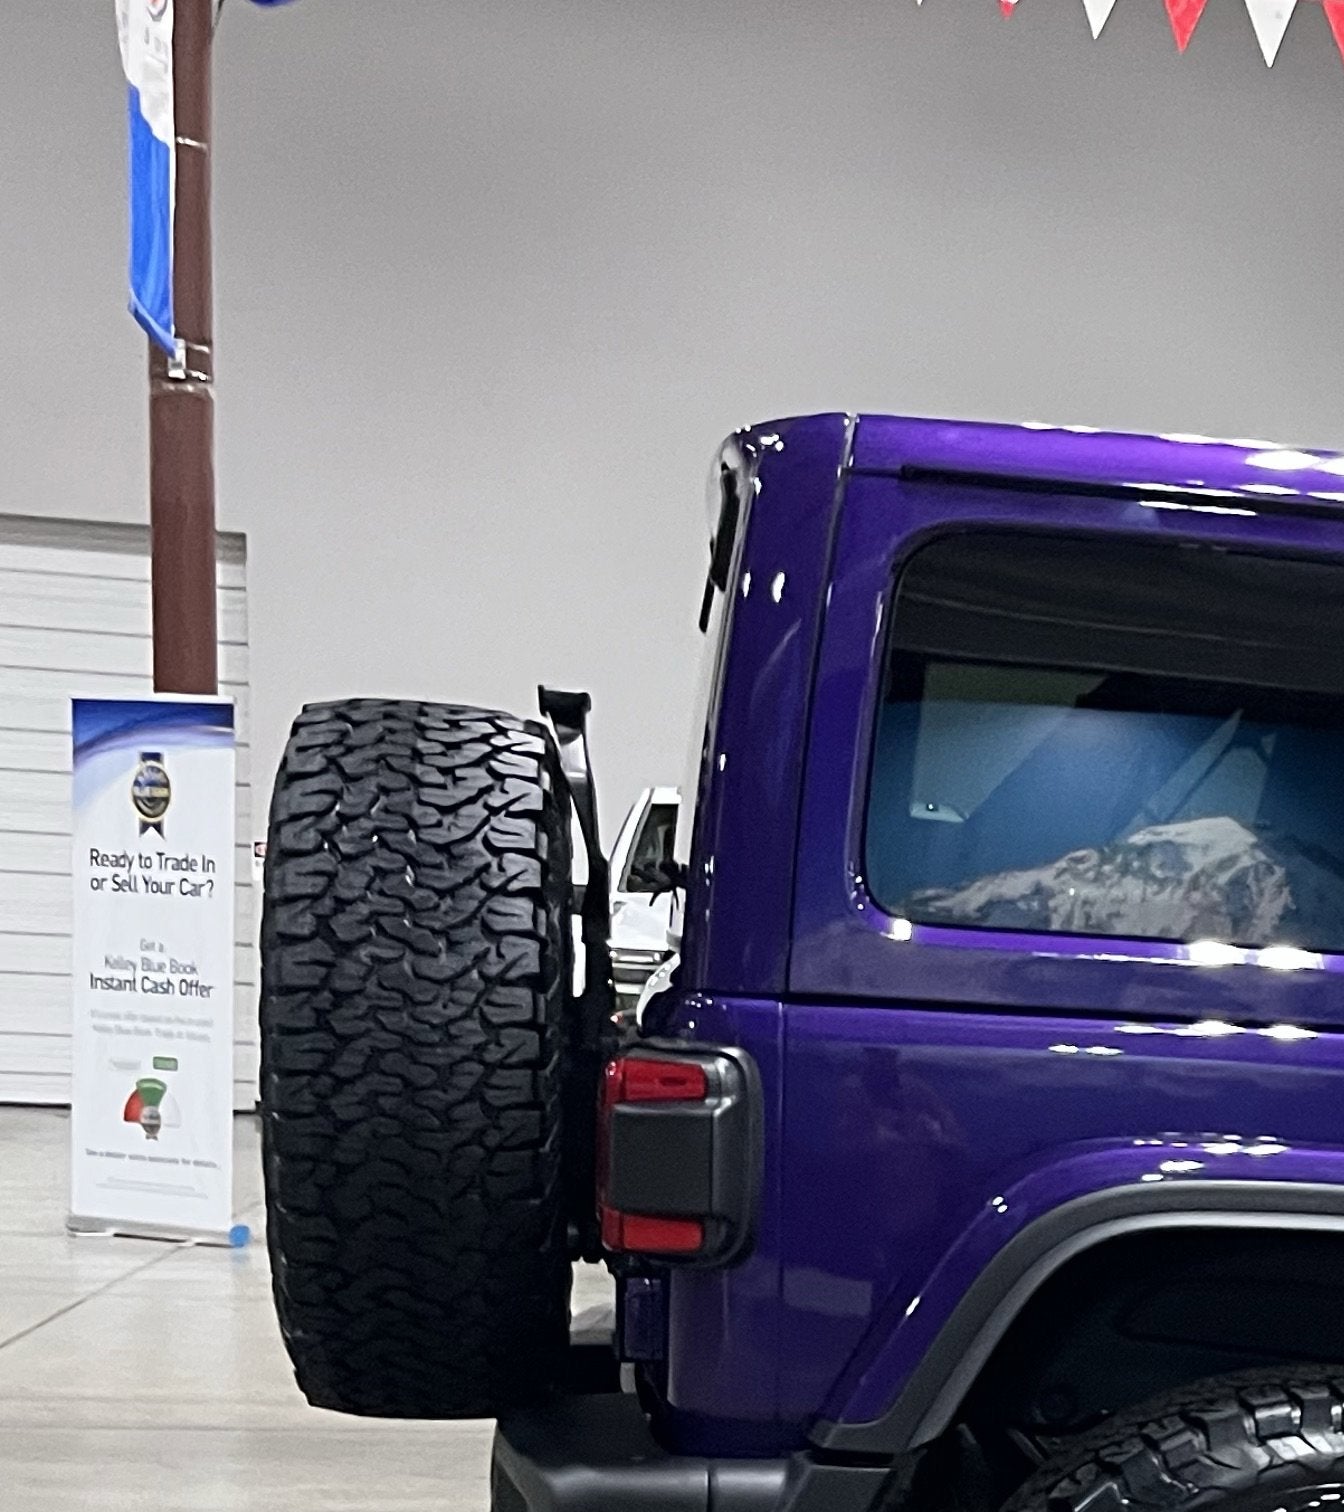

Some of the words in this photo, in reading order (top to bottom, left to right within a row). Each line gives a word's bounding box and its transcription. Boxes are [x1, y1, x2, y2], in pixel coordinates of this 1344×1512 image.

[90, 848, 134, 873] Ready
[138, 852, 153, 869] to
[156, 851, 198, 872] Trade
[202, 854, 216, 873] In
[91, 877, 108, 891] or
[112, 873, 138, 893] Sell
[142, 874, 175, 895] Your
[180, 877, 214, 898] Car?
[141, 957, 167, 973] Blue
[170, 958, 198, 974] Book
[90, 972, 137, 992] Instant
[141, 976, 175, 994] Cash
[180, 979, 214, 998] Offer
